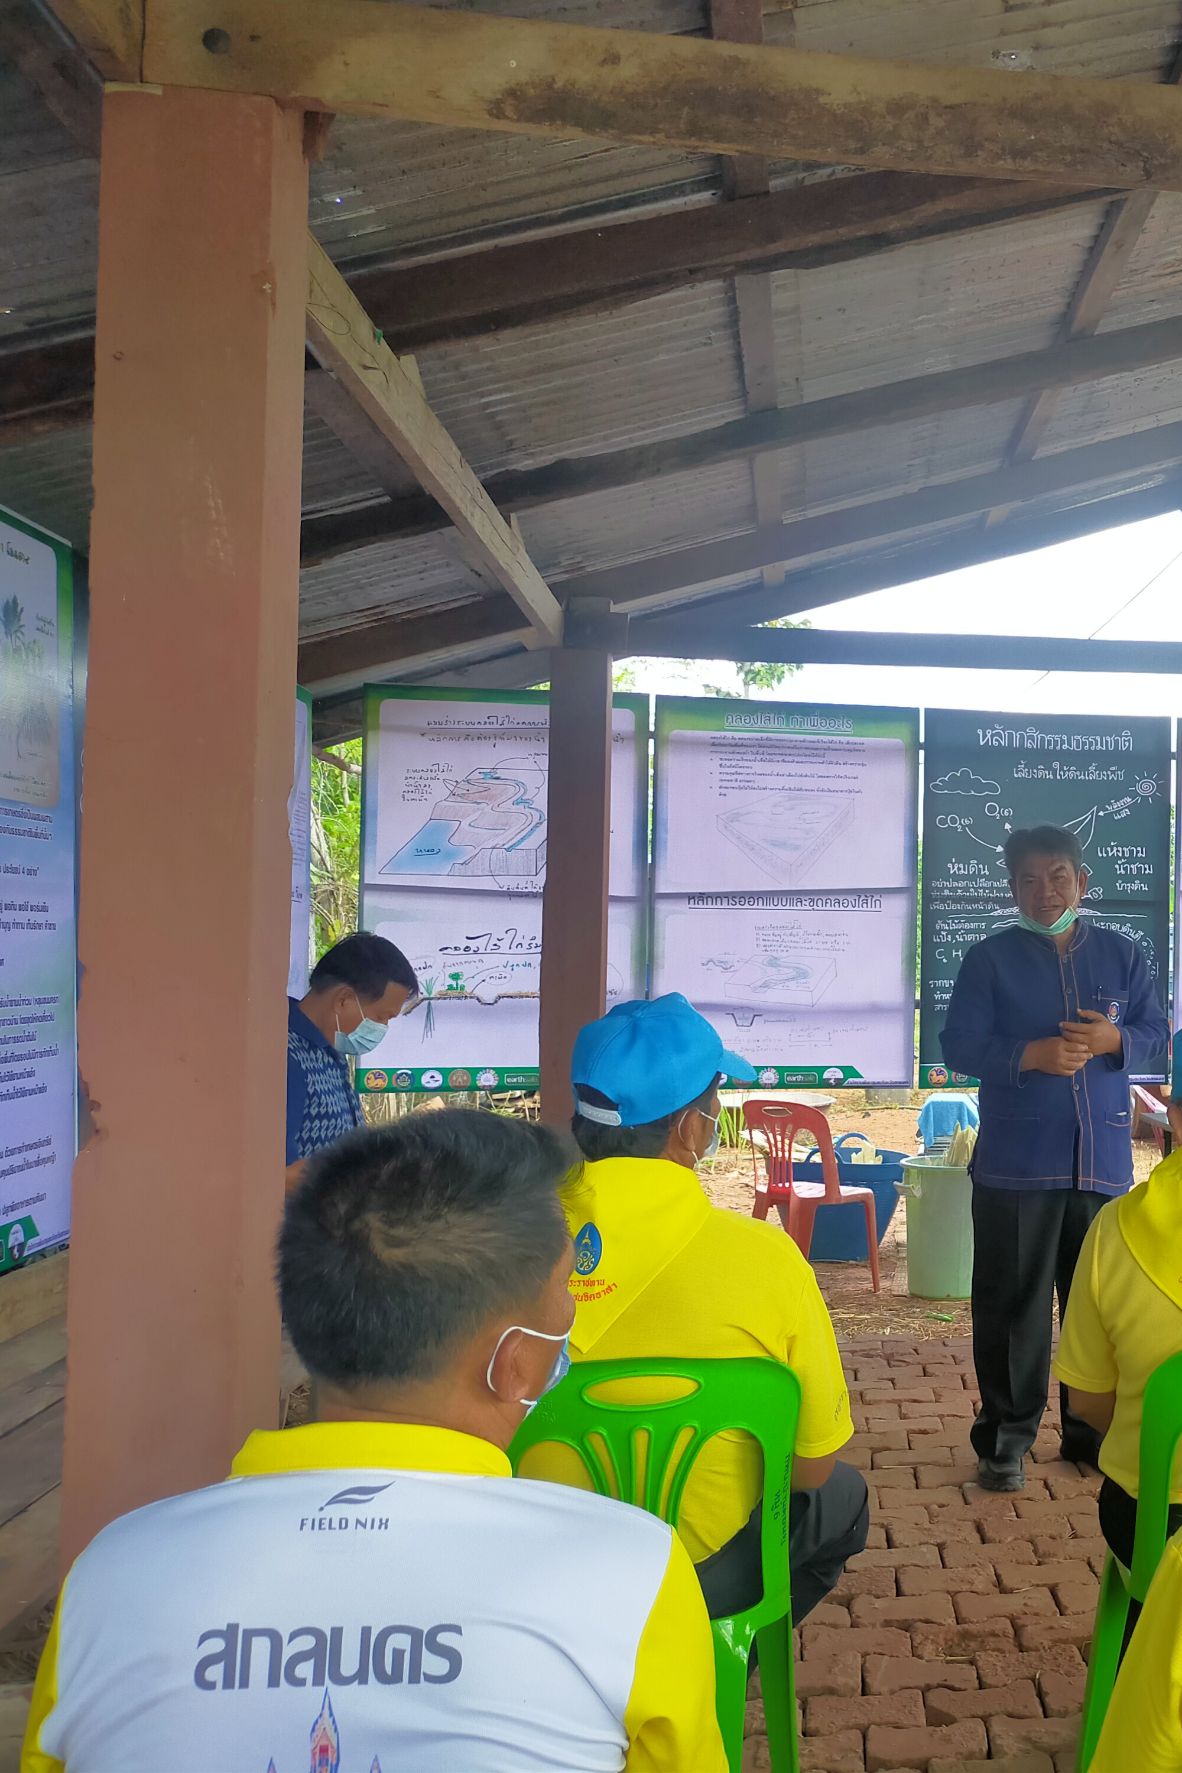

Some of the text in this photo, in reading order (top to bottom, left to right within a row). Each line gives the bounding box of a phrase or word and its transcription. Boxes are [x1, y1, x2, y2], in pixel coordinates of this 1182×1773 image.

[977, 724, 1133, 751] หลักกสิกรรมธรรมชาติ
[1013, 760, 1053, 779] เลี้ยงดิน
[1097, 841, 1146, 857] แห้งชาม
[947, 857, 990, 875] ห่มดิน
[1115, 858, 1153, 875] น้ำชาม
[687, 893, 882, 911] หลักการออกแบบและขุดคลองไส้ไก่
[568, 1279, 605, 1288] ระราชทาน
[300, 1517, 349, 1531] FIELD
[194, 1623, 463, 1691] สกลนคร
